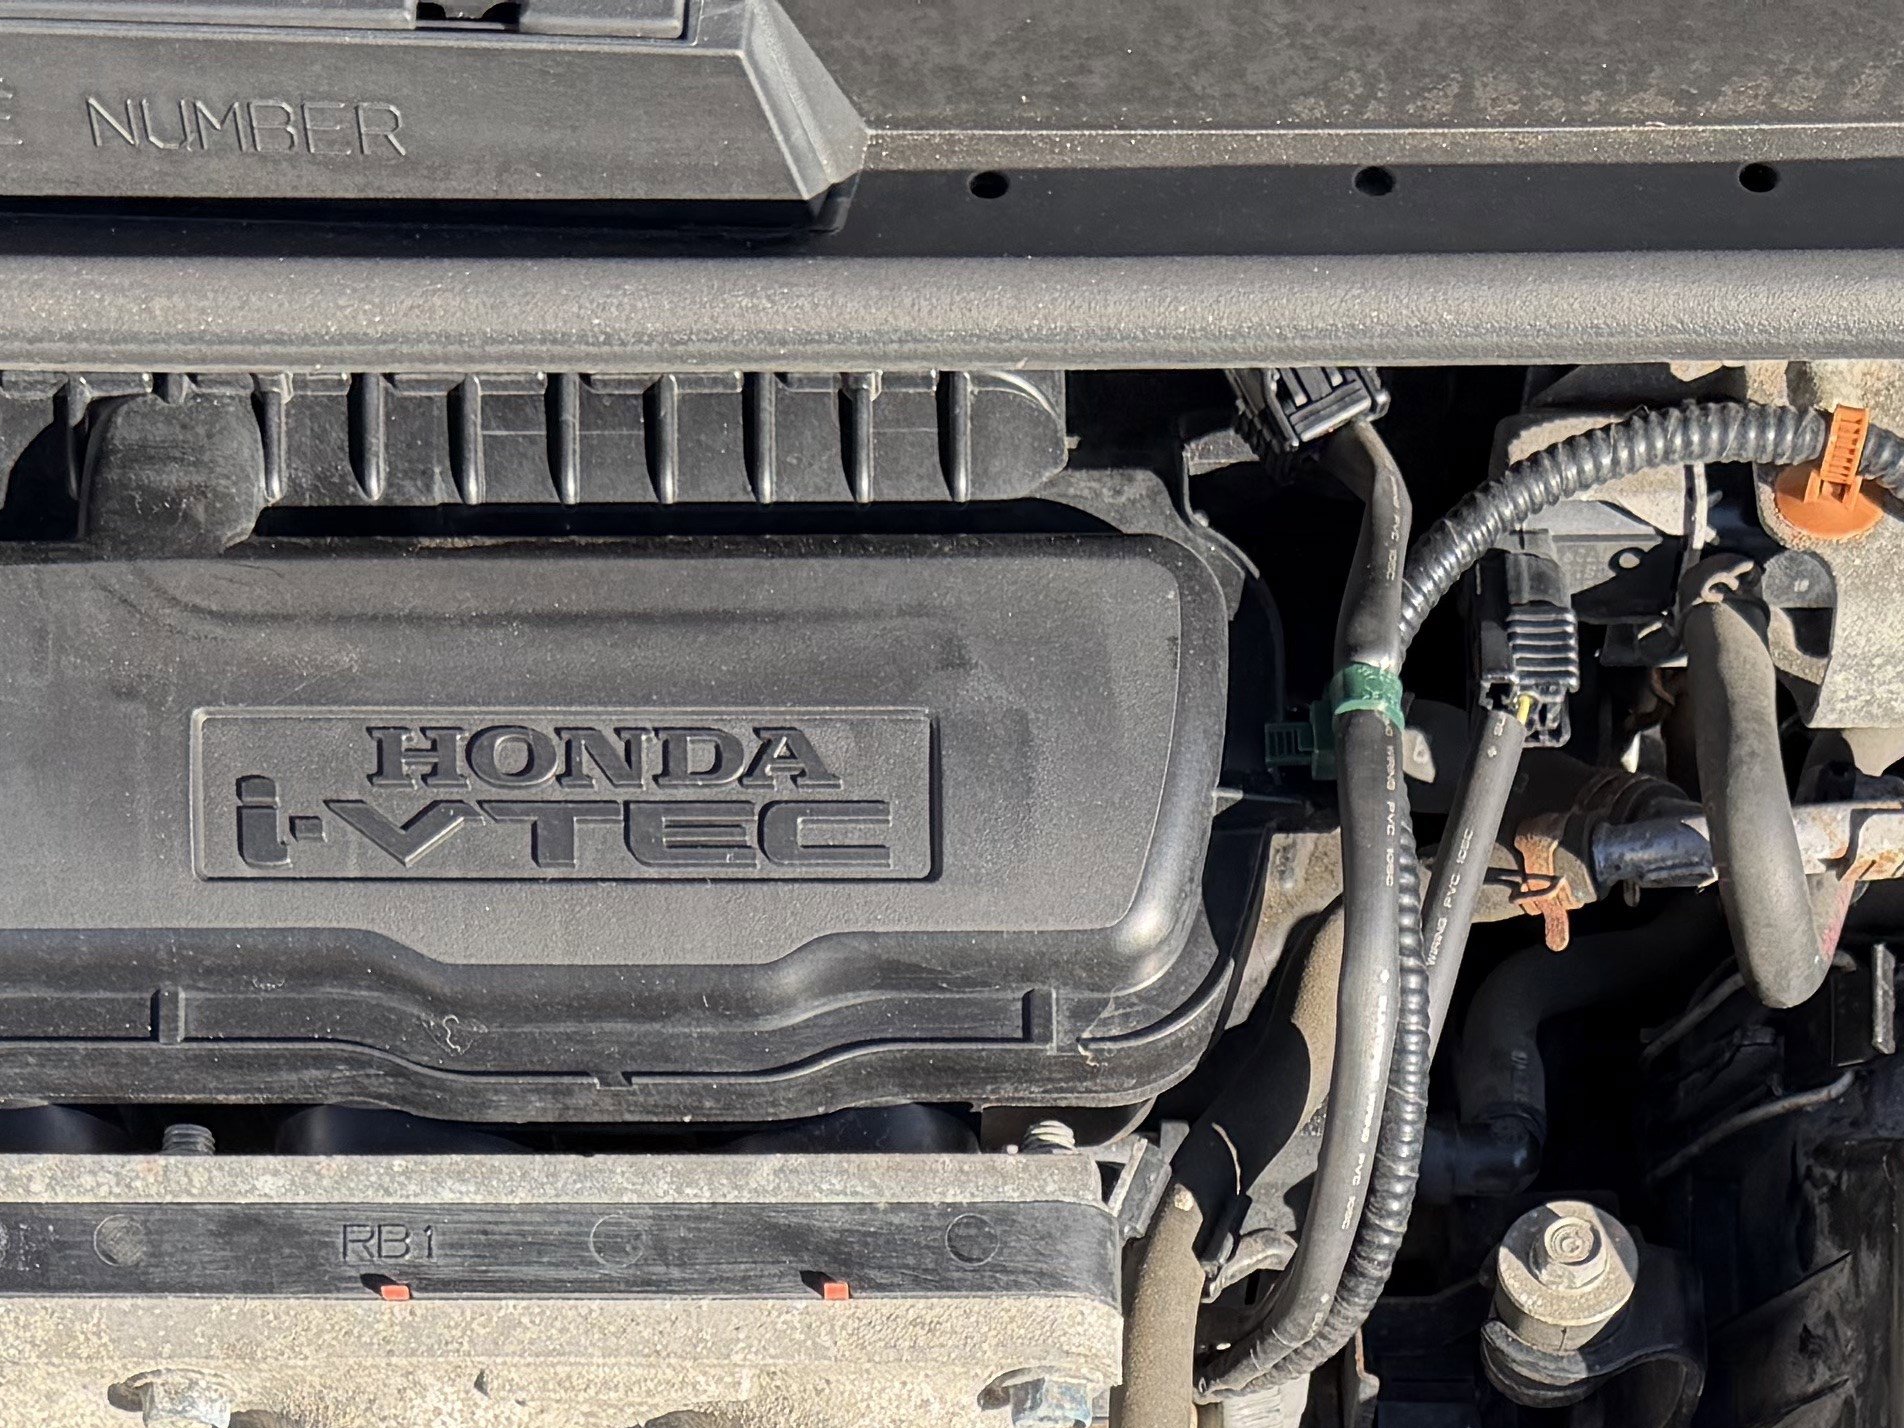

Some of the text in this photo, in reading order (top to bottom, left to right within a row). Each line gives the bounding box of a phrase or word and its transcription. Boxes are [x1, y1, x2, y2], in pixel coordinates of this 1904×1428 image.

[86, 96, 407, 157] NUMBER
[365, 725, 843, 791] HONDA
[236, 775, 893, 870] i-VTEC
[342, 1224, 433, 1260] RB1
